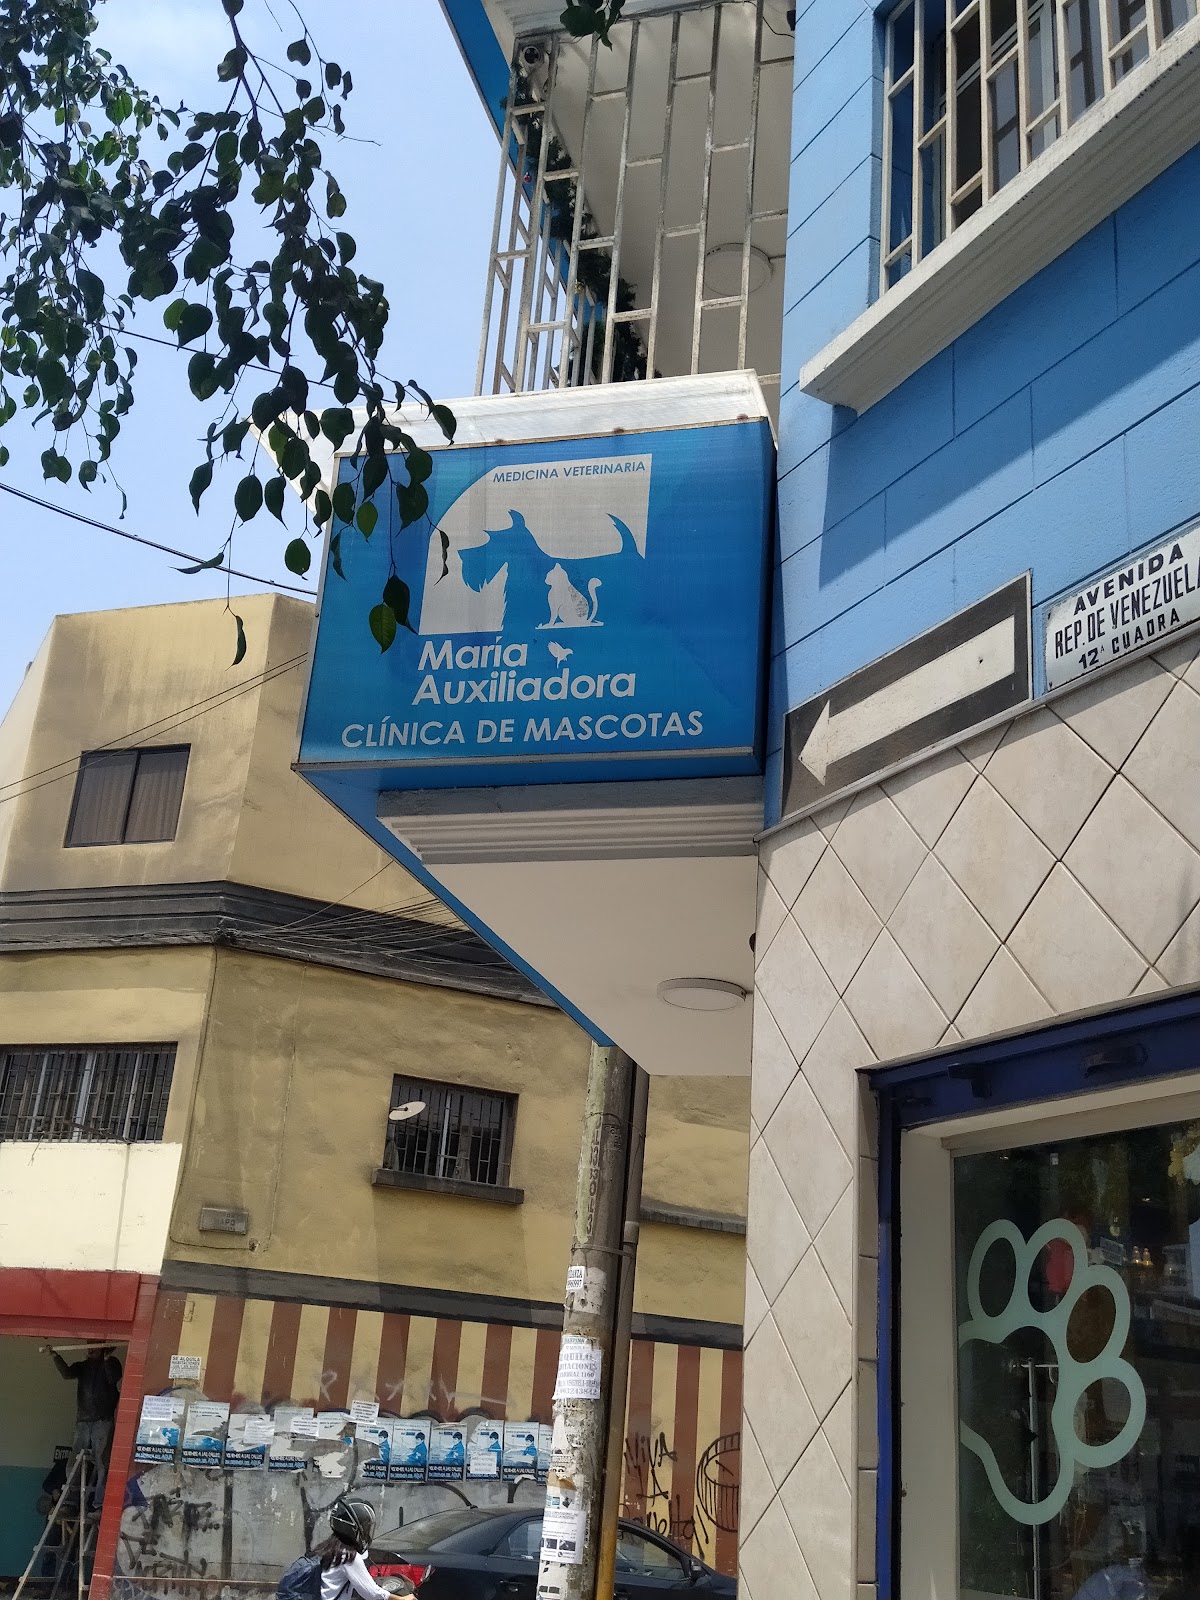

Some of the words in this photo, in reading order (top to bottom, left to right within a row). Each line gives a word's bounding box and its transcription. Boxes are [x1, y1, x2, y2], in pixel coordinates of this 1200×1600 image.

[493, 466, 559, 483] MEDICINA
[563, 461, 646, 478] VETERINARIA
[1073, 543, 1184, 616] AVENIDA
[1111, 607, 1180, 655] CUADRA
[418, 636, 528, 671] María
[412, 668, 637, 706] Auxiliadora
[341, 715, 465, 748] CLÍNICA
[476, 718, 515, 745] DE
[523, 710, 704, 744] MASCOTAS
